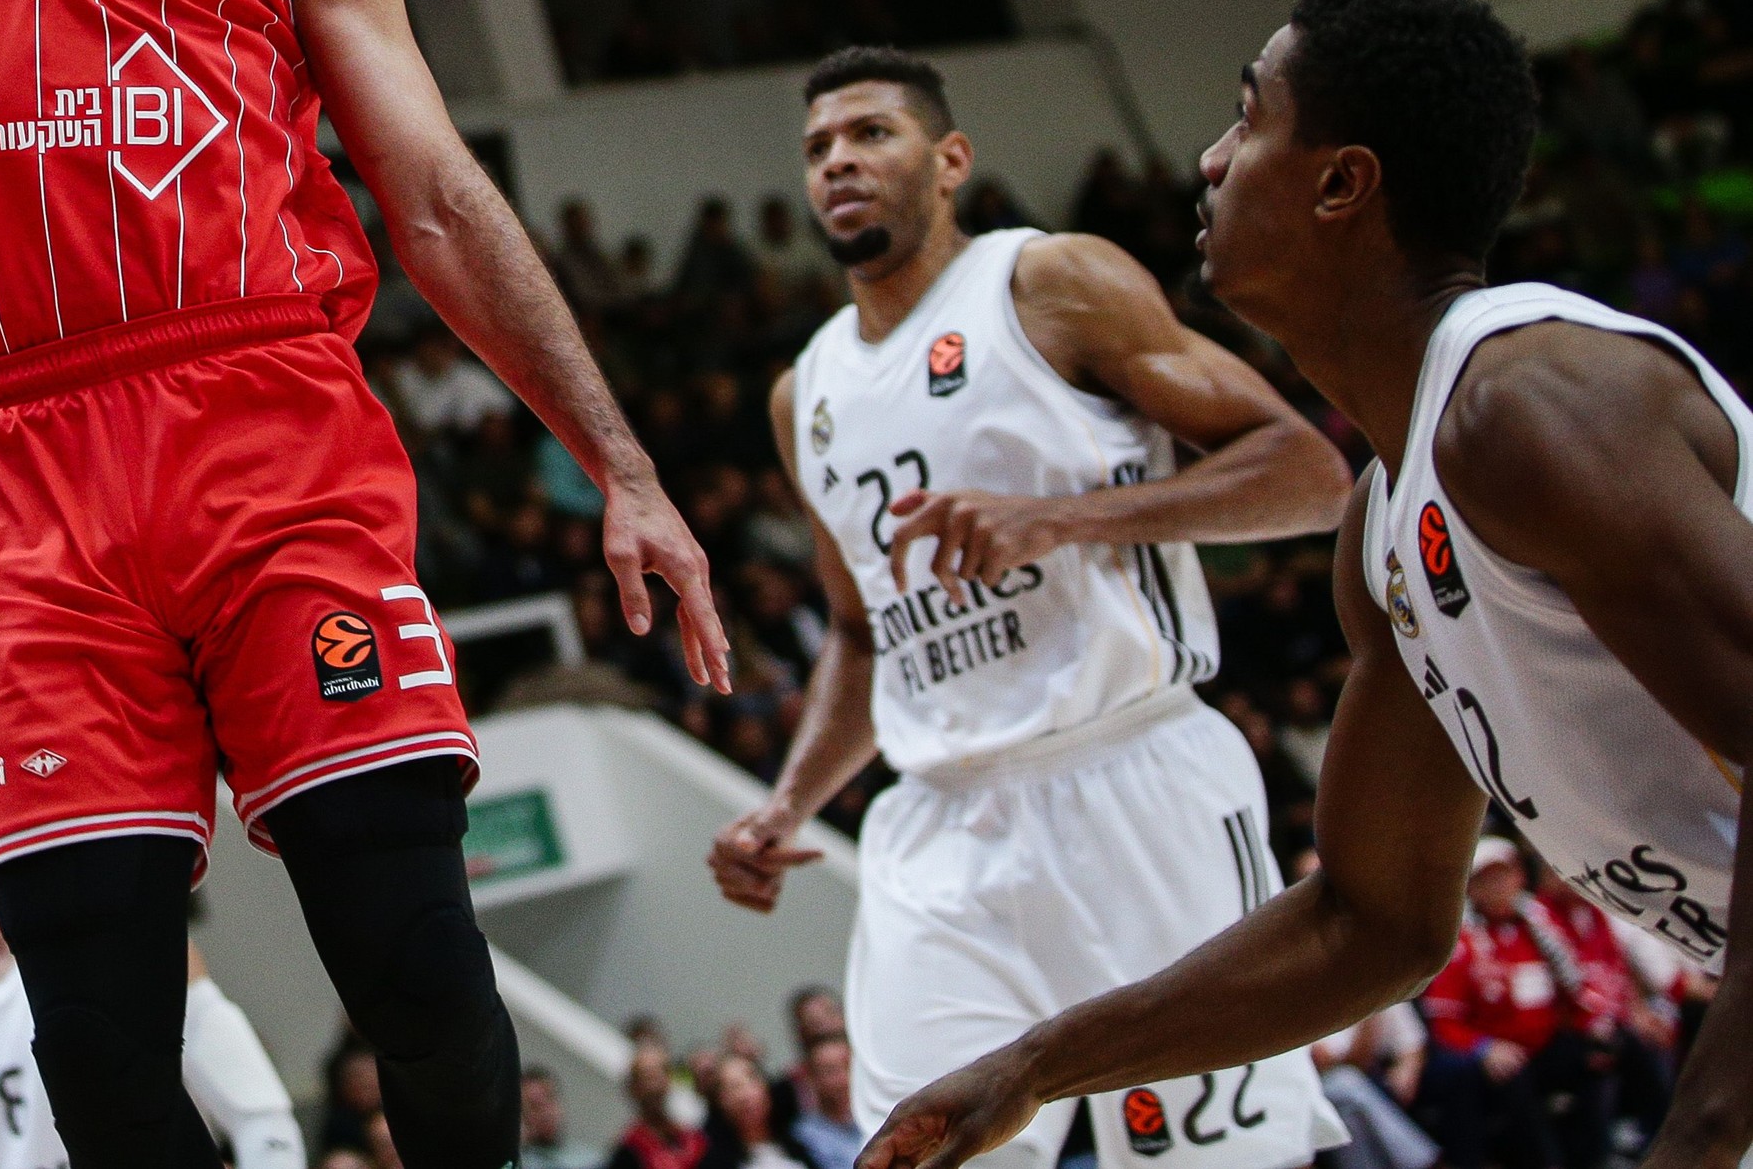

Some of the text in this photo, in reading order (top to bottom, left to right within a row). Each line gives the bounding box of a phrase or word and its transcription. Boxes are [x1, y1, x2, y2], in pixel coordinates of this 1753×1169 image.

[54, 87, 103, 116] בית
[112, 85, 183, 147] IBI
[380, 584, 453, 690] 3
[925, 608, 1027, 684] BETTER
